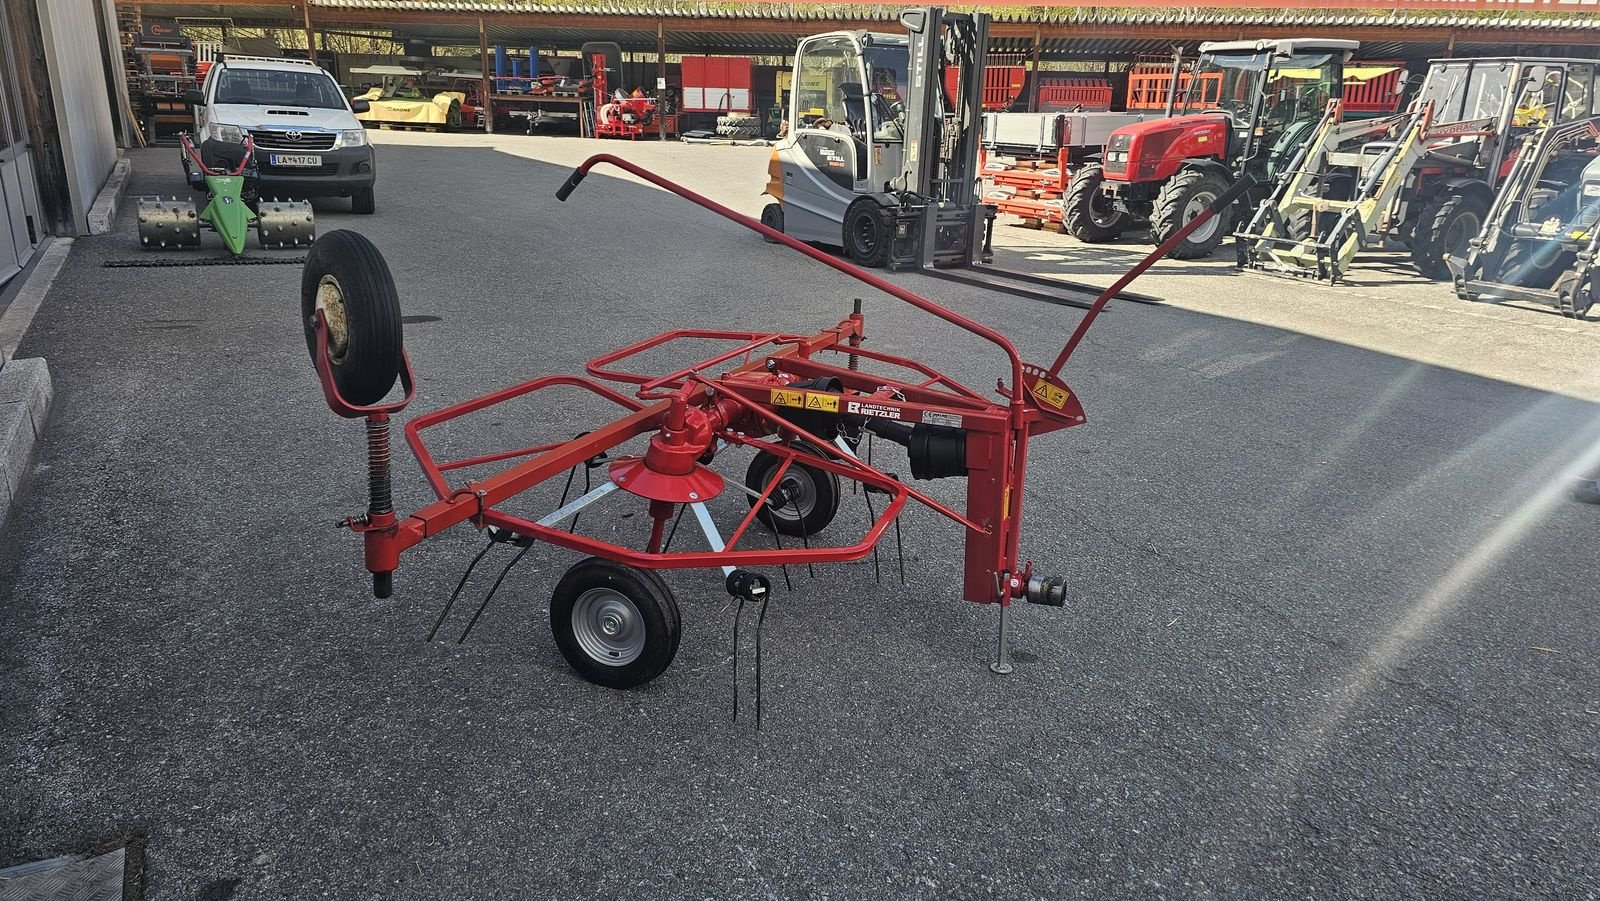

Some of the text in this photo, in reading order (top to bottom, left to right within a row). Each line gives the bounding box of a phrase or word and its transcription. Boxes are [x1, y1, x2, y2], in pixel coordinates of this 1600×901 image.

[915, 37, 925, 88] STILL
[277, 156, 318, 165] LA 417 CU
[861, 402, 901, 413] LANDTECHNIK
[861, 408, 901, 420] RIETZLER
